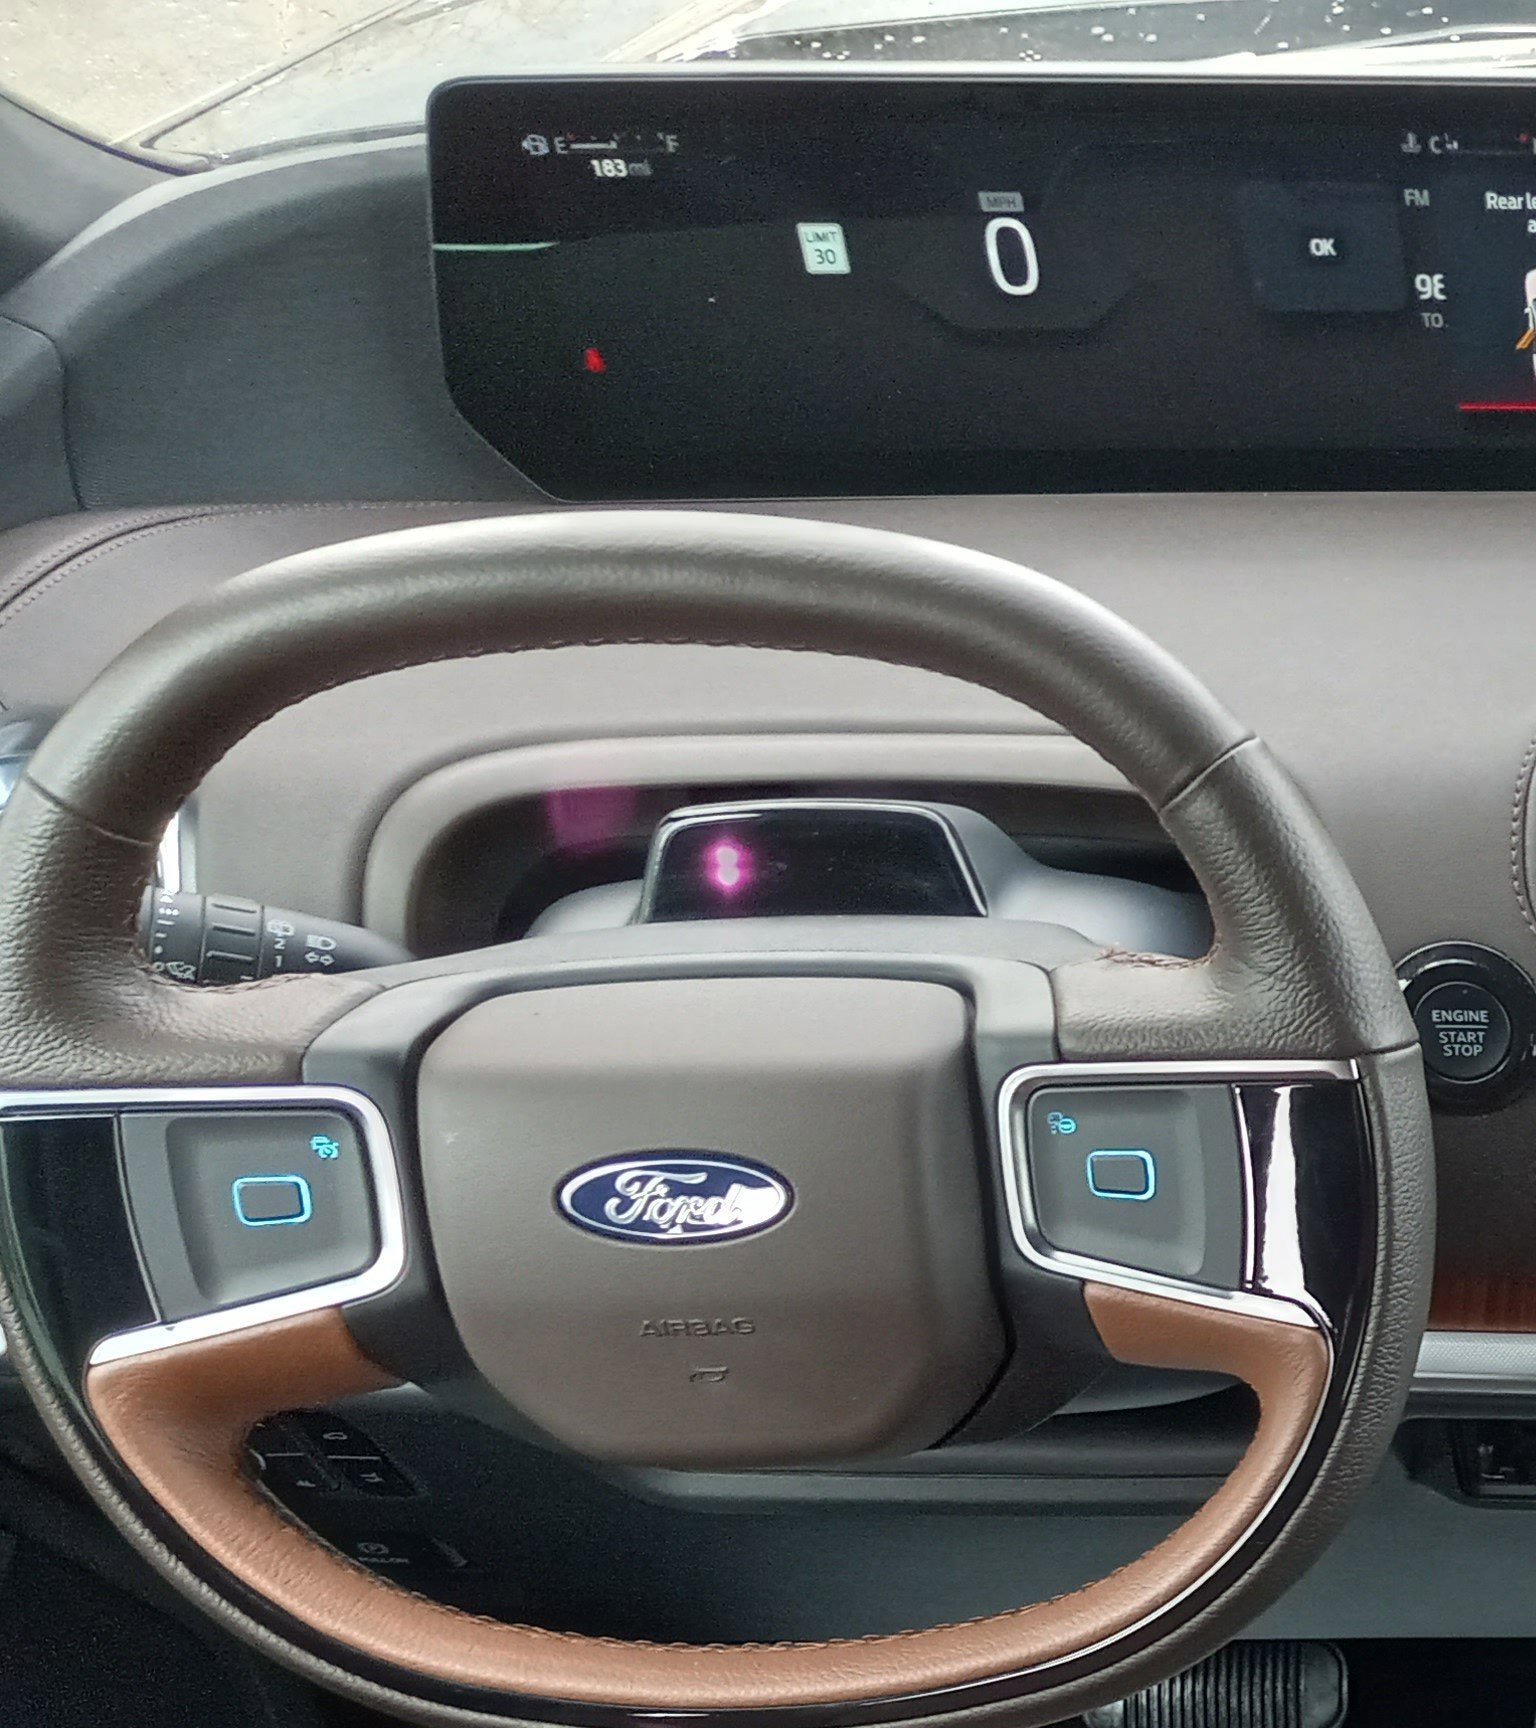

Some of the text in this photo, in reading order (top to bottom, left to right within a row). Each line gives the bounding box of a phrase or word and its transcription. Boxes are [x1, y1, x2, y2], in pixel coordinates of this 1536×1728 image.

[590, 159, 628, 177] 183
[1404, 189, 1430, 207] FM
[1485, 192, 1523, 210] Rear
[805, 231, 837, 243] LIMIT
[814, 249, 837, 264] 30
[985, 217, 1039, 296] 0
[1310, 238, 1337, 257] OK
[1431, 1009, 1489, 1023] ENGINE
[1439, 1031, 1486, 1044] START
[1443, 1044, 1483, 1057] STOP
[604, 1170, 743, 1227] Ford
[639, 1317, 756, 1337] AIRBAG
